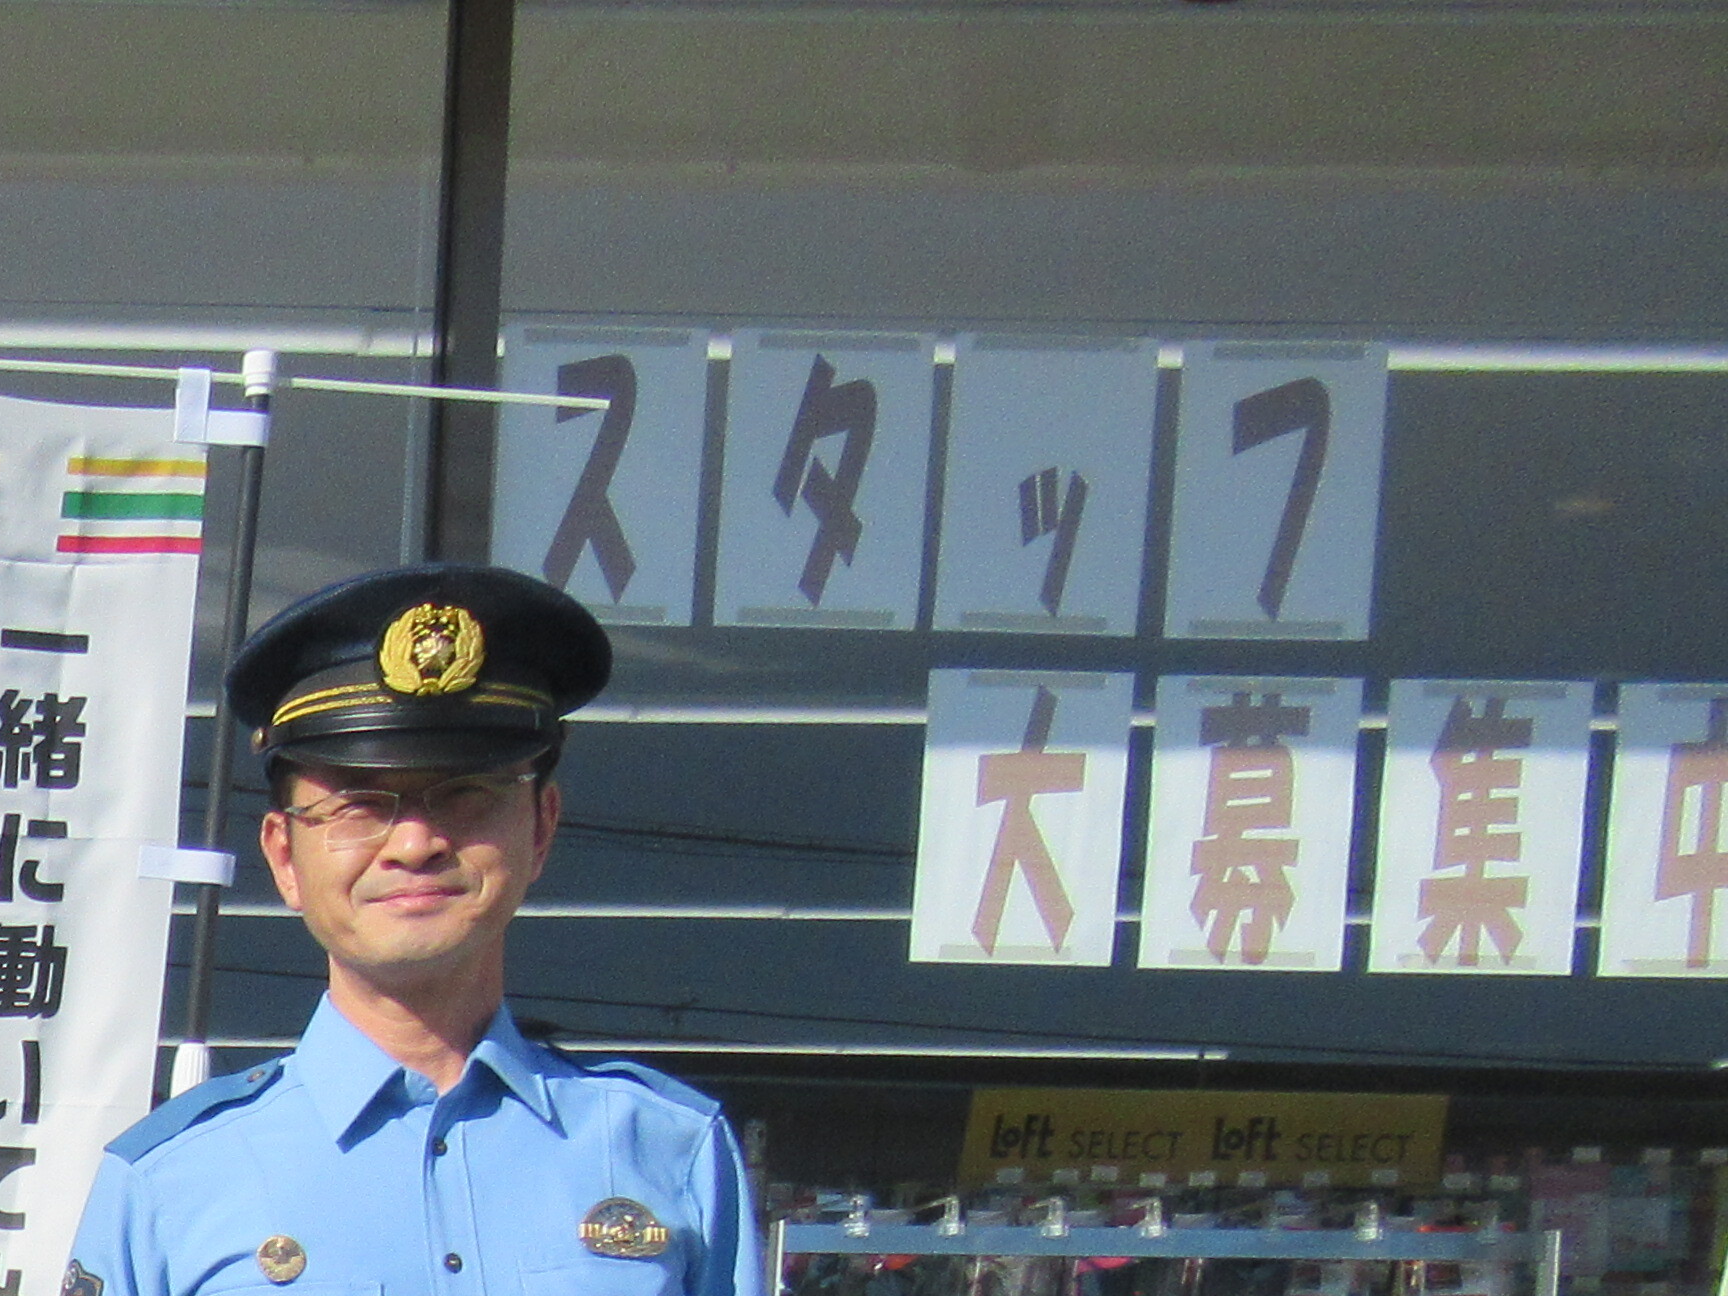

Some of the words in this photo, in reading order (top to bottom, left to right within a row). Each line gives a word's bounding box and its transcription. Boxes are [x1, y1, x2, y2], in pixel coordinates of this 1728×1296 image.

[544, 352, 1332, 621] スタッフ
[1067, 1131, 1183, 1160] SELECT
[1296, 1132, 1412, 1163] SELECT
